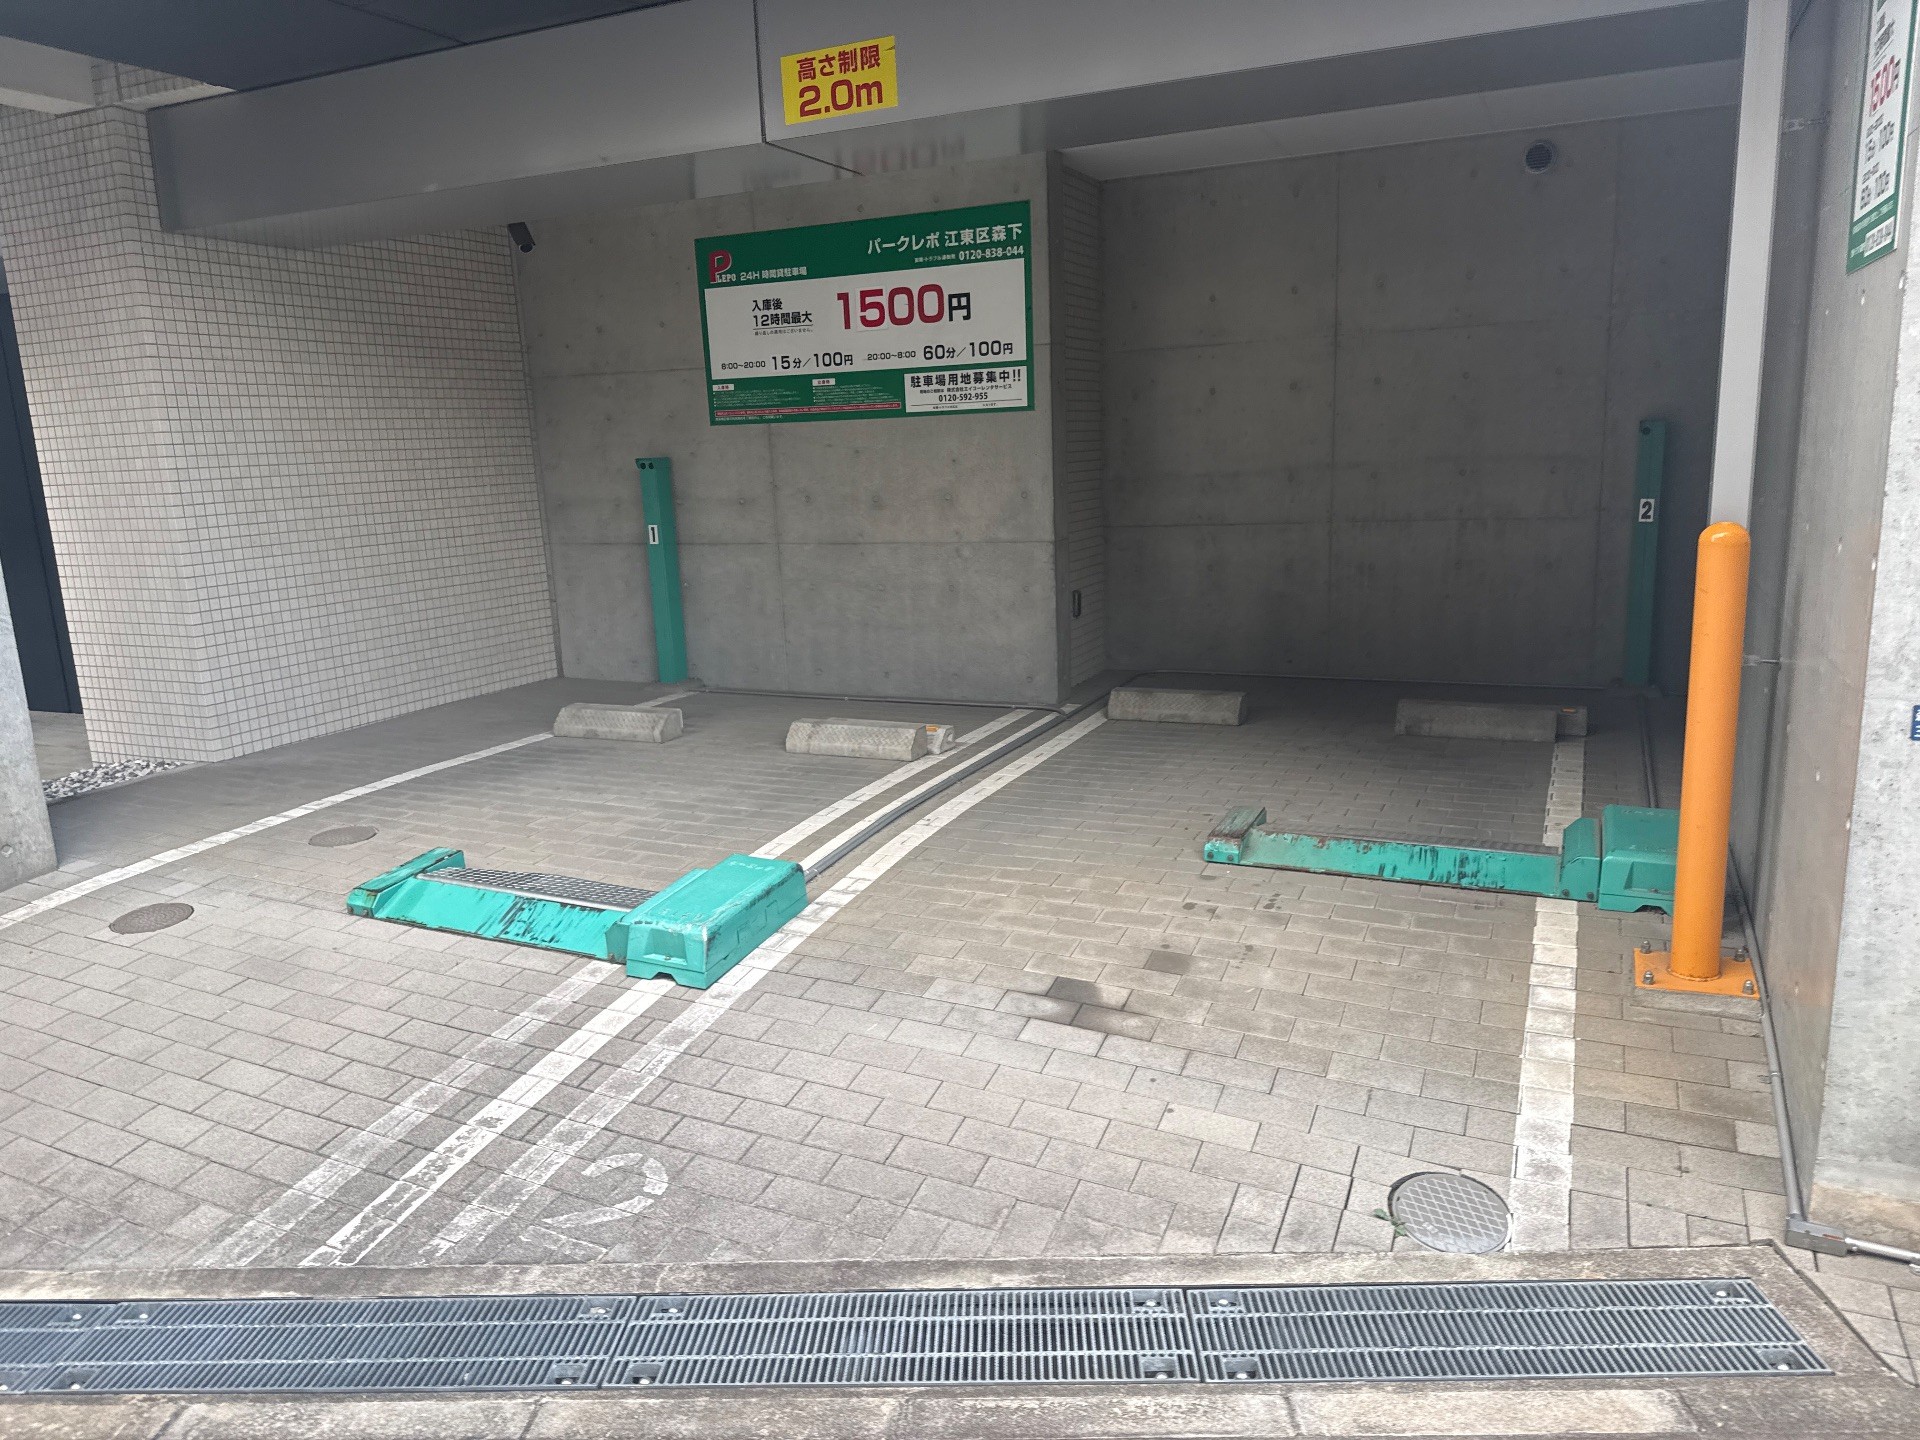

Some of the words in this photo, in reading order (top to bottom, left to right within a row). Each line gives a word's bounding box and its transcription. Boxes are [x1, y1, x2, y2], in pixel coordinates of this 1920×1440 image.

[797, 44, 881, 82] 高さ制限
[799, 79, 883, 117] 2.0m
[867, 232, 940, 255] パークレポ
[944, 223, 1023, 248] 江東区森下
[958, 245, 1024, 261] 0120-838-044
[752, 298, 783, 312] 入庫後
[837, 283, 972, 330] 1500円
[753, 311, 813, 327] 12時間最大
[938, 392, 988, 402] 0120-592-955
[1641, 501, 1652, 519] 2
